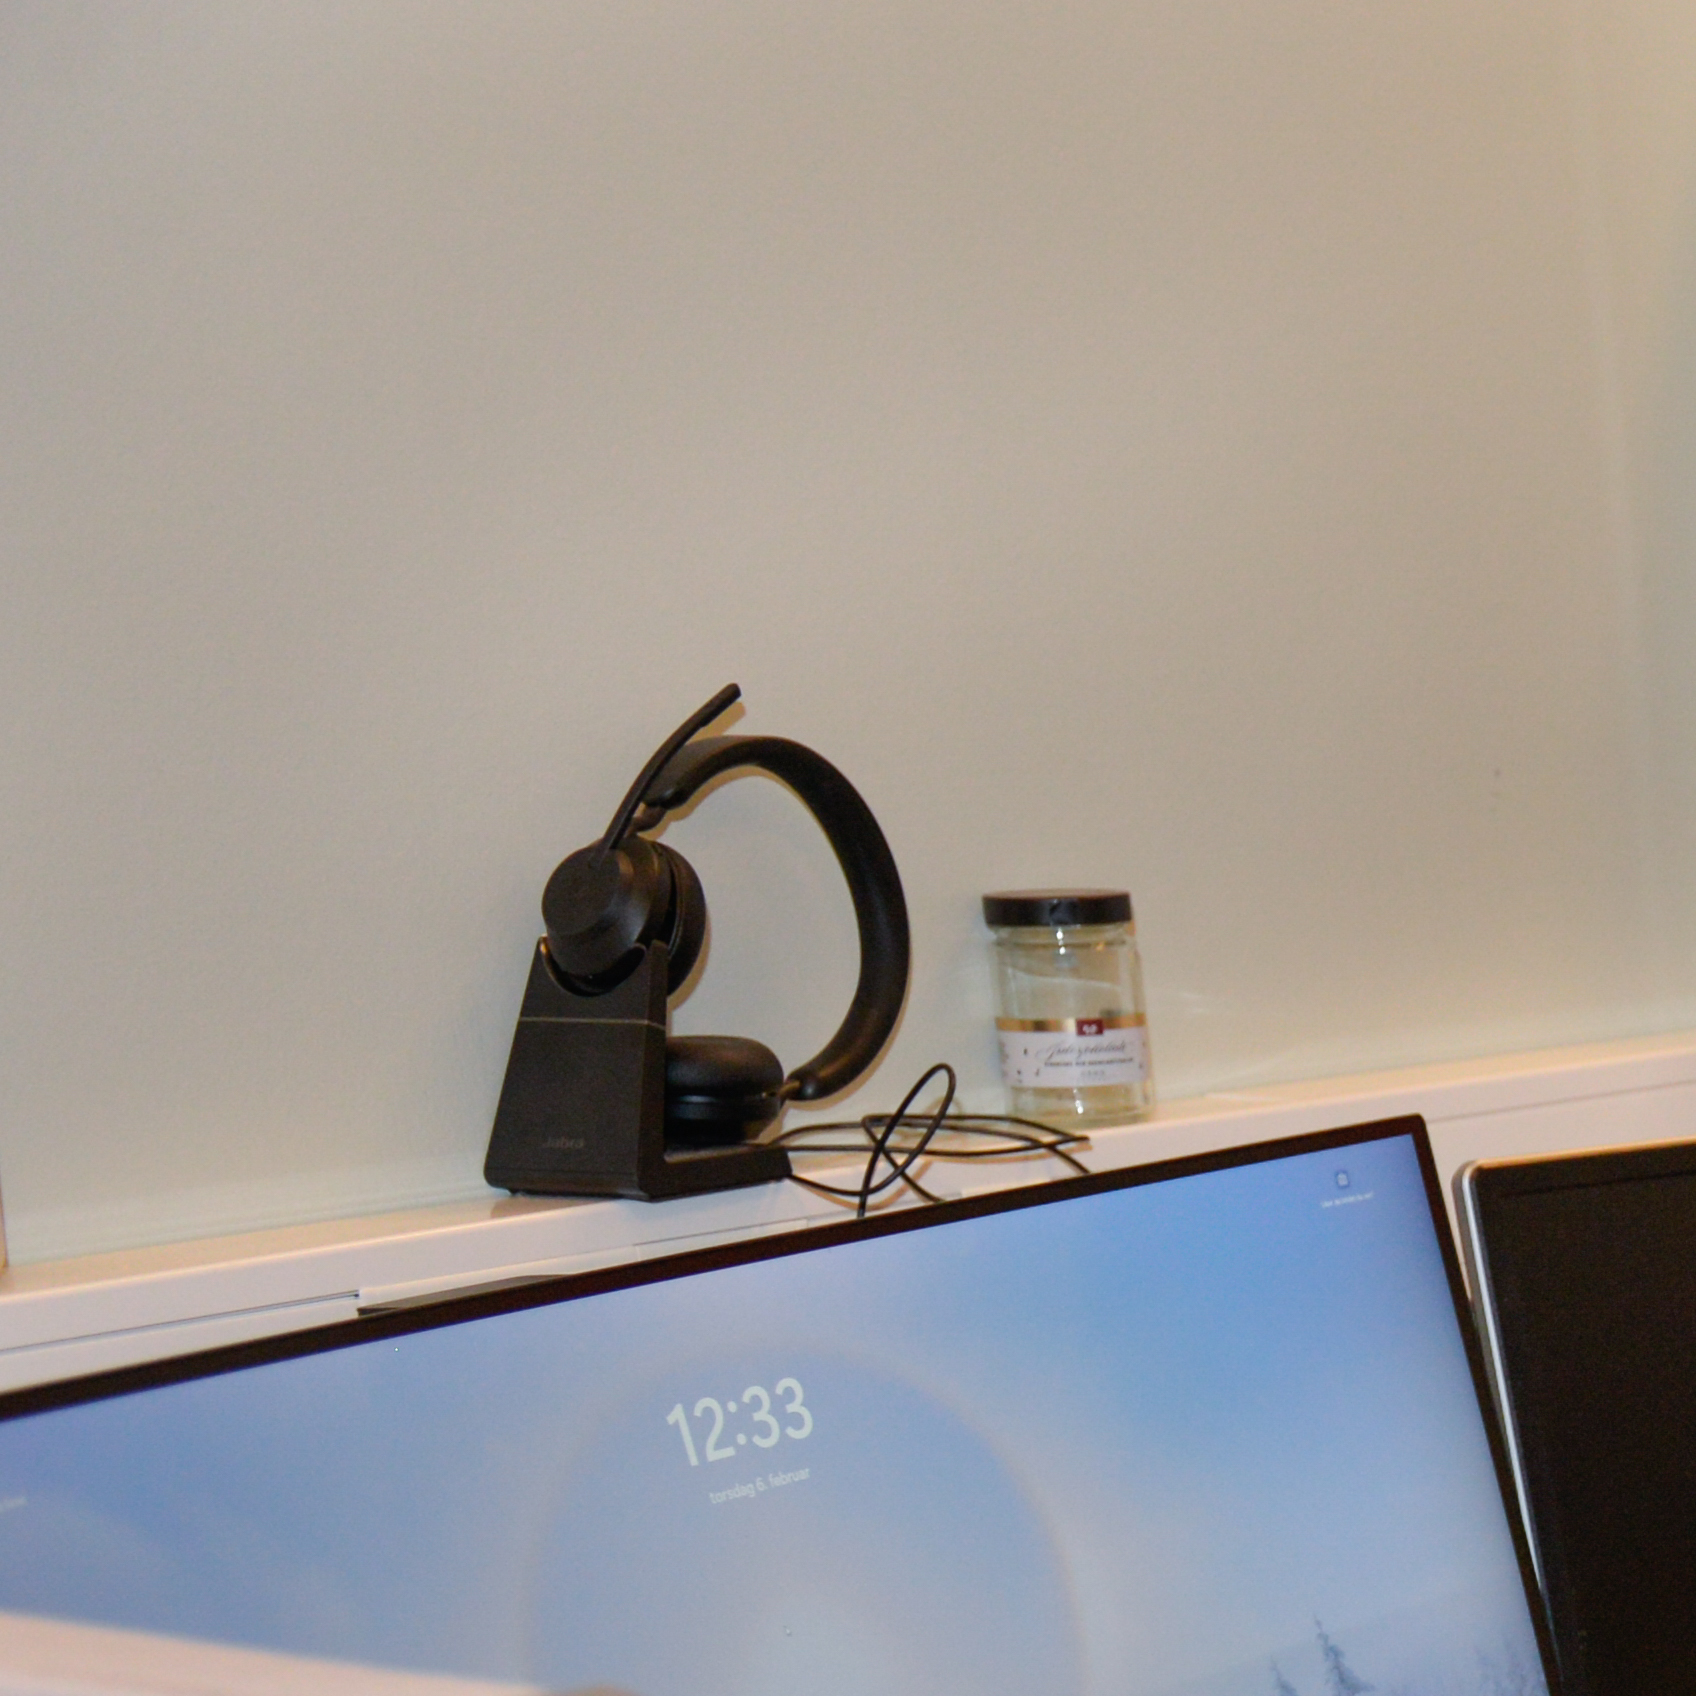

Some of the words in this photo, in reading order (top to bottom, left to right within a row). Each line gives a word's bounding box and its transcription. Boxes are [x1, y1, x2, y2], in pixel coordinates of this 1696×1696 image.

[666, 1376, 814, 1467] 12:33
[708, 1482, 756, 1504] torsdag
[756, 1476, 768, 1492] 6.
[768, 1467, 810, 1488] februar
